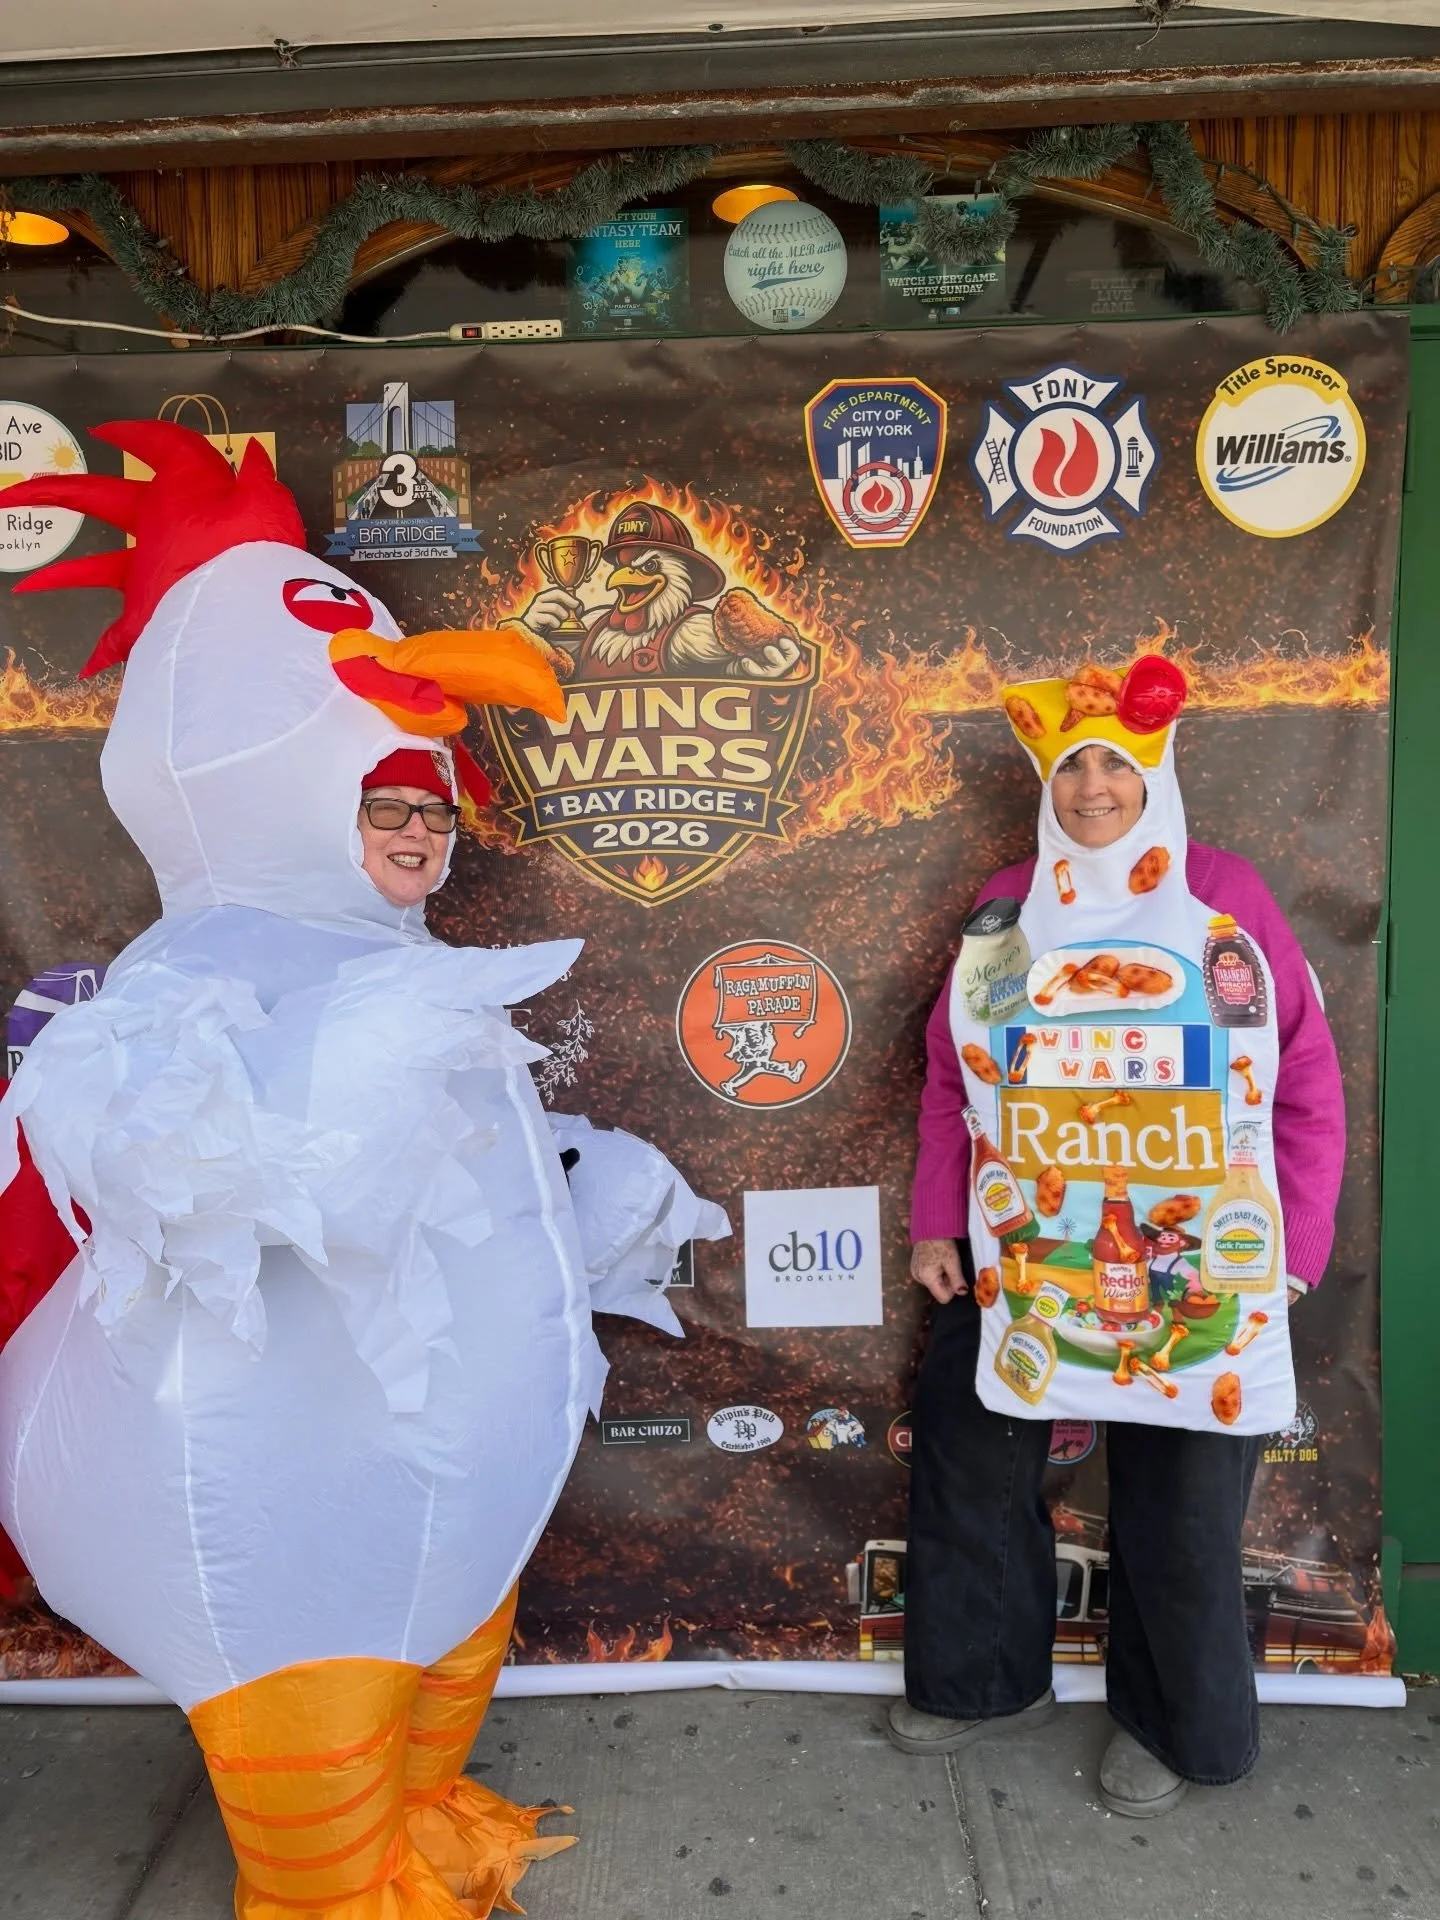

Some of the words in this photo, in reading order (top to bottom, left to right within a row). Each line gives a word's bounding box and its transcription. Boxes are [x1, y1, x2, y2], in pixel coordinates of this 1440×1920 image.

[630, 212, 657, 221] YOUR
[573, 224, 637, 239] ANTASY
[639, 223, 681, 236] TEAM
[615, 239, 641, 248] HERE
[728, 244, 750, 258] Catch
[752, 247, 767, 259] all
[768, 247, 783, 259] the
[786, 243, 816, 258] MLB
[817, 239, 842, 254] action
[748, 261, 784, 280] right
[788, 259, 821, 275] here
[888, 275, 925, 288] WATCH
[928, 274, 964, 285] EVERY
[964, 272, 999, 283] GAME.
[903, 286, 938, 297] EVERY
[939, 283, 984, 296] SUNDAY.
[1220, 366, 1261, 396] Title
[1265, 359, 1341, 391] Sponsor
[1032, 378, 1096, 403] FDNY
[823, 402, 849, 430] FIRE
[849, 391, 932, 426] DEPARTMENT
[852, 411, 882, 422] CITY
[884, 409, 903, 421] OF
[6, 416, 42, 434] Ave
[843, 426, 873, 438] NEW
[876, 425, 912, 437] YORK
[379, 453, 419, 508] 3
[7, 512, 53, 535] Ridge
[618, 520, 646, 534] FDNY
[1028, 515, 1104, 536] FOUNDATION
[359, 527, 392, 543] BAY
[394, 525, 445, 542] RIDGE
[0, 538, 41, 551] ooklyn
[359, 550, 402, 559] Merchants
[404, 548, 414, 558] of
[415, 548, 429, 557] 3rd
[430, 548, 448, 557] Ave
[544, 686, 753, 737] WING
[523, 735, 772, 788] WARS
[560, 789, 627, 817] BAY
[634, 788, 736, 815] RIDGE
[592, 820, 710, 848] 2026
[966, 946, 1023, 985] Marie's
[724, 973, 811, 998] RAGAMUFFIN
[747, 995, 801, 1017] PARADE
[1037, 1026, 1147, 1053] WING
[1058, 1056, 1175, 1085] WARS
[1006, 1102, 1219, 1171] Ranch
[1213, 1212, 1233, 1231] SWEET
[1234, 1210, 1252, 1220] BABY
[1252, 1211, 1269, 1232] RAY'S
[768, 1229, 863, 1273] cb10
[1215, 1240, 1235, 1250] Garlic
[1235, 1240, 1265, 1250] Parmesan
[775, 1274, 856, 1283] BROOKLYN
[1100, 1271, 1145, 1289] RedHot
[1103, 1287, 1142, 1302] Wings
[713, 1408, 750, 1426] Pipin's
[752, 1408, 775, 1423] Pub
[610, 1426, 636, 1437] BAR
[638, 1425, 682, 1436] CHUZO
[1263, 1449, 1297, 1463] SALTY
[1298, 1448, 1318, 1462] DOG
